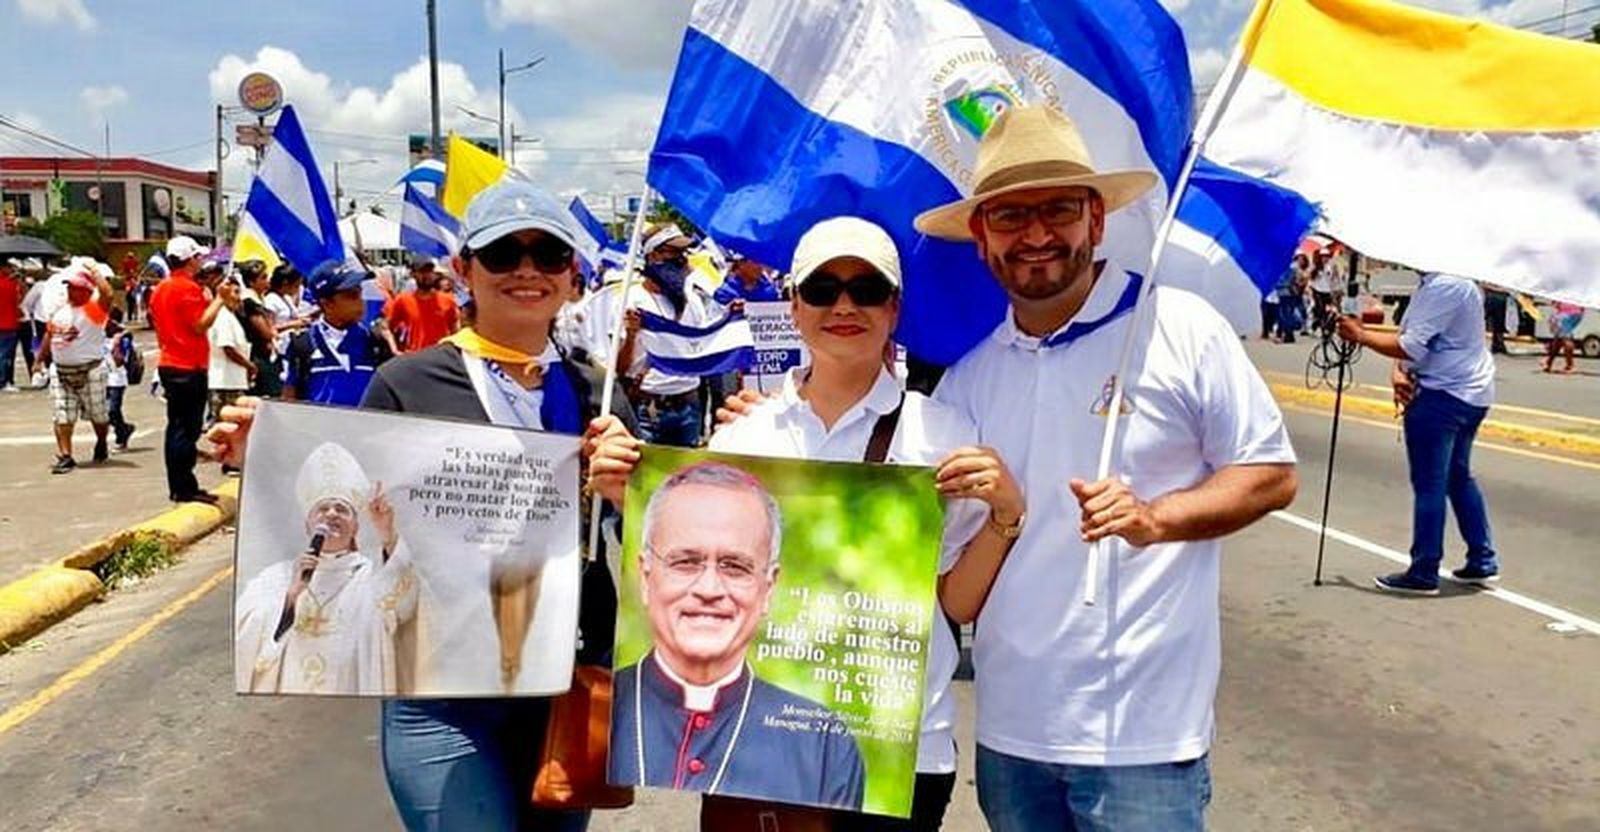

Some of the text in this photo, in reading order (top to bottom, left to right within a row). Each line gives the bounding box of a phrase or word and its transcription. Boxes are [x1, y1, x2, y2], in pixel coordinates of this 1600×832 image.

[756, 350, 789, 362] EDRO
[442, 459, 553, 483] las balas pueden
[477, 448, 523, 466] verdad
[525, 456, 552, 473] que
[423, 473, 488, 490] atravesar
[491, 477, 510, 492] las
[409, 487, 442, 501] pero
[444, 491, 464, 502] no
[465, 493, 508, 506] matar
[510, 494, 530, 508] los
[422, 506, 431, 518] y
[435, 504, 502, 521] proyectos
[504, 507, 522, 521] de
[843, 590, 924, 617] Obispos
[797, 610, 923, 636] estaremos al
[766, 621, 922, 655] lado de nuestro
[756, 642, 826, 663] pueblo
[843, 651, 920, 674] aunque
[815, 666, 918, 692] nos cueste
[834, 683, 853, 703] la
[815, 721, 830, 733] 24
[830, 722, 845, 735] de
